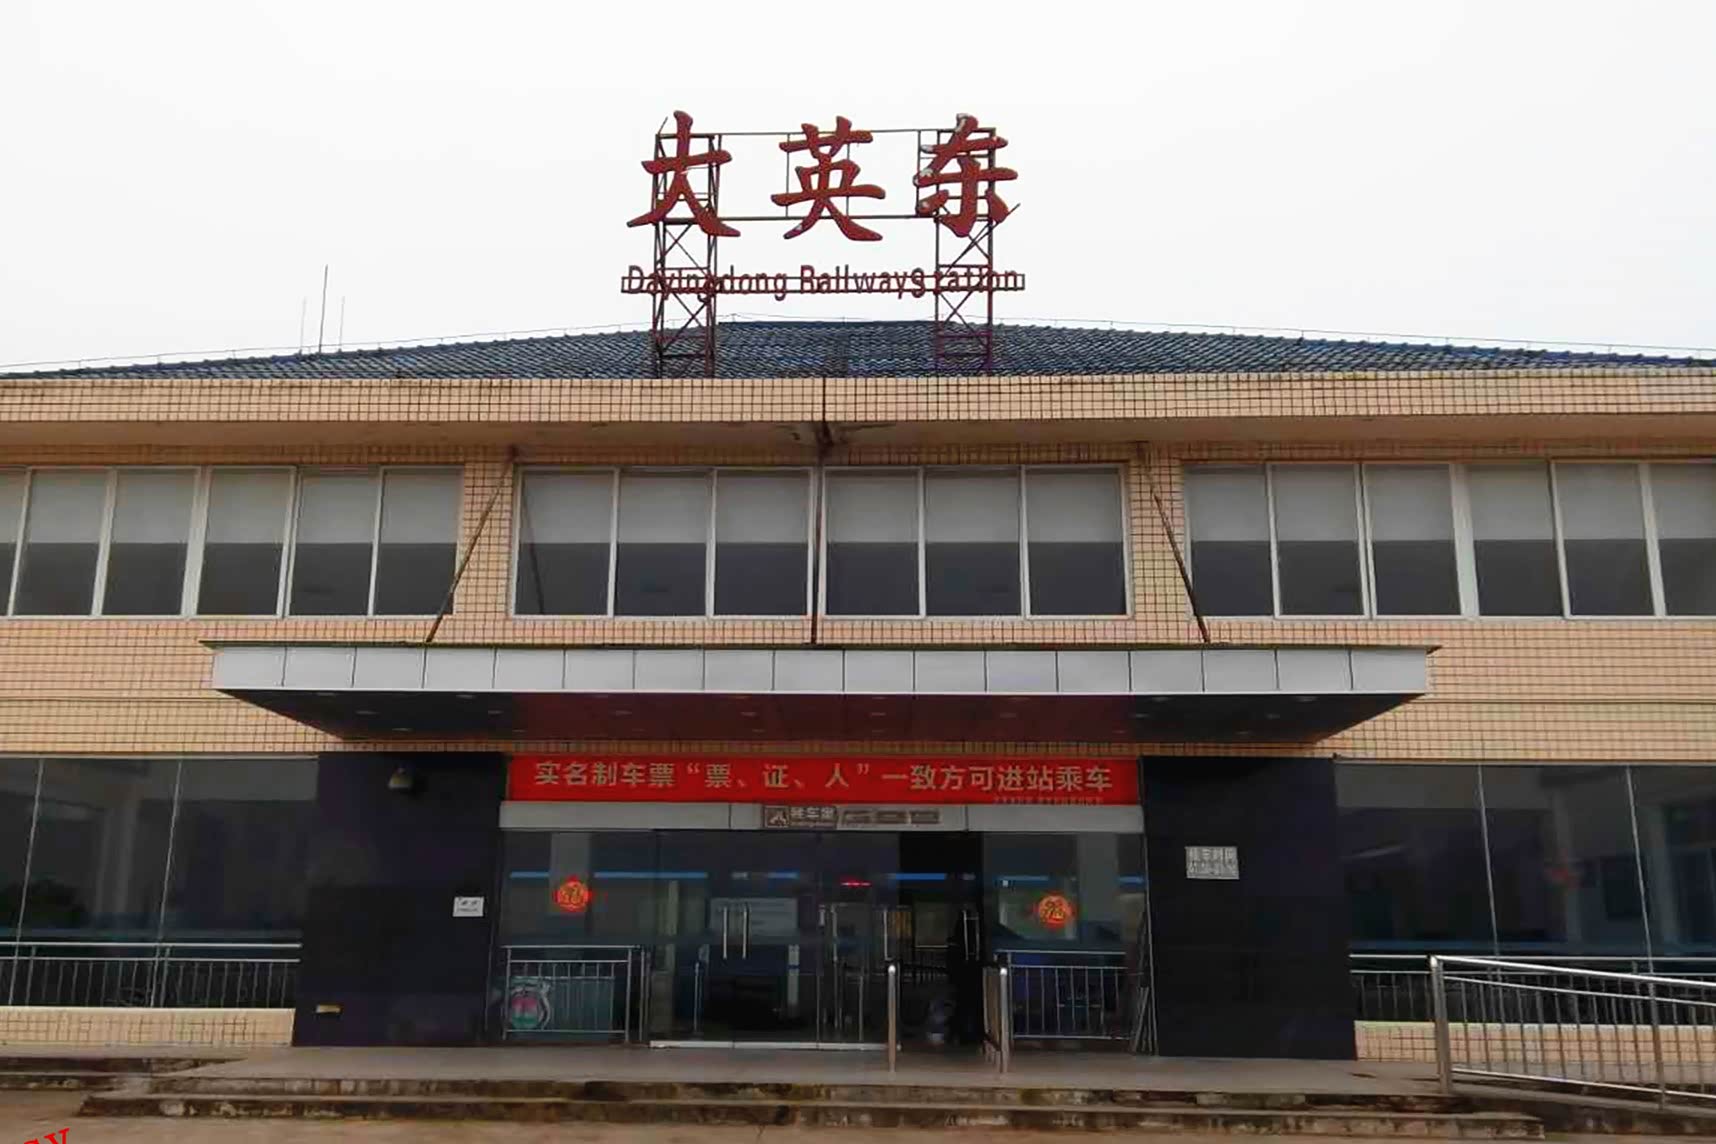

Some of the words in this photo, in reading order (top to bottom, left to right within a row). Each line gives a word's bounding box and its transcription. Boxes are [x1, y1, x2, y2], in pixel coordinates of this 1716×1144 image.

[627, 110, 1018, 241] 大英东
[628, 264, 787, 301] Dayingdong
